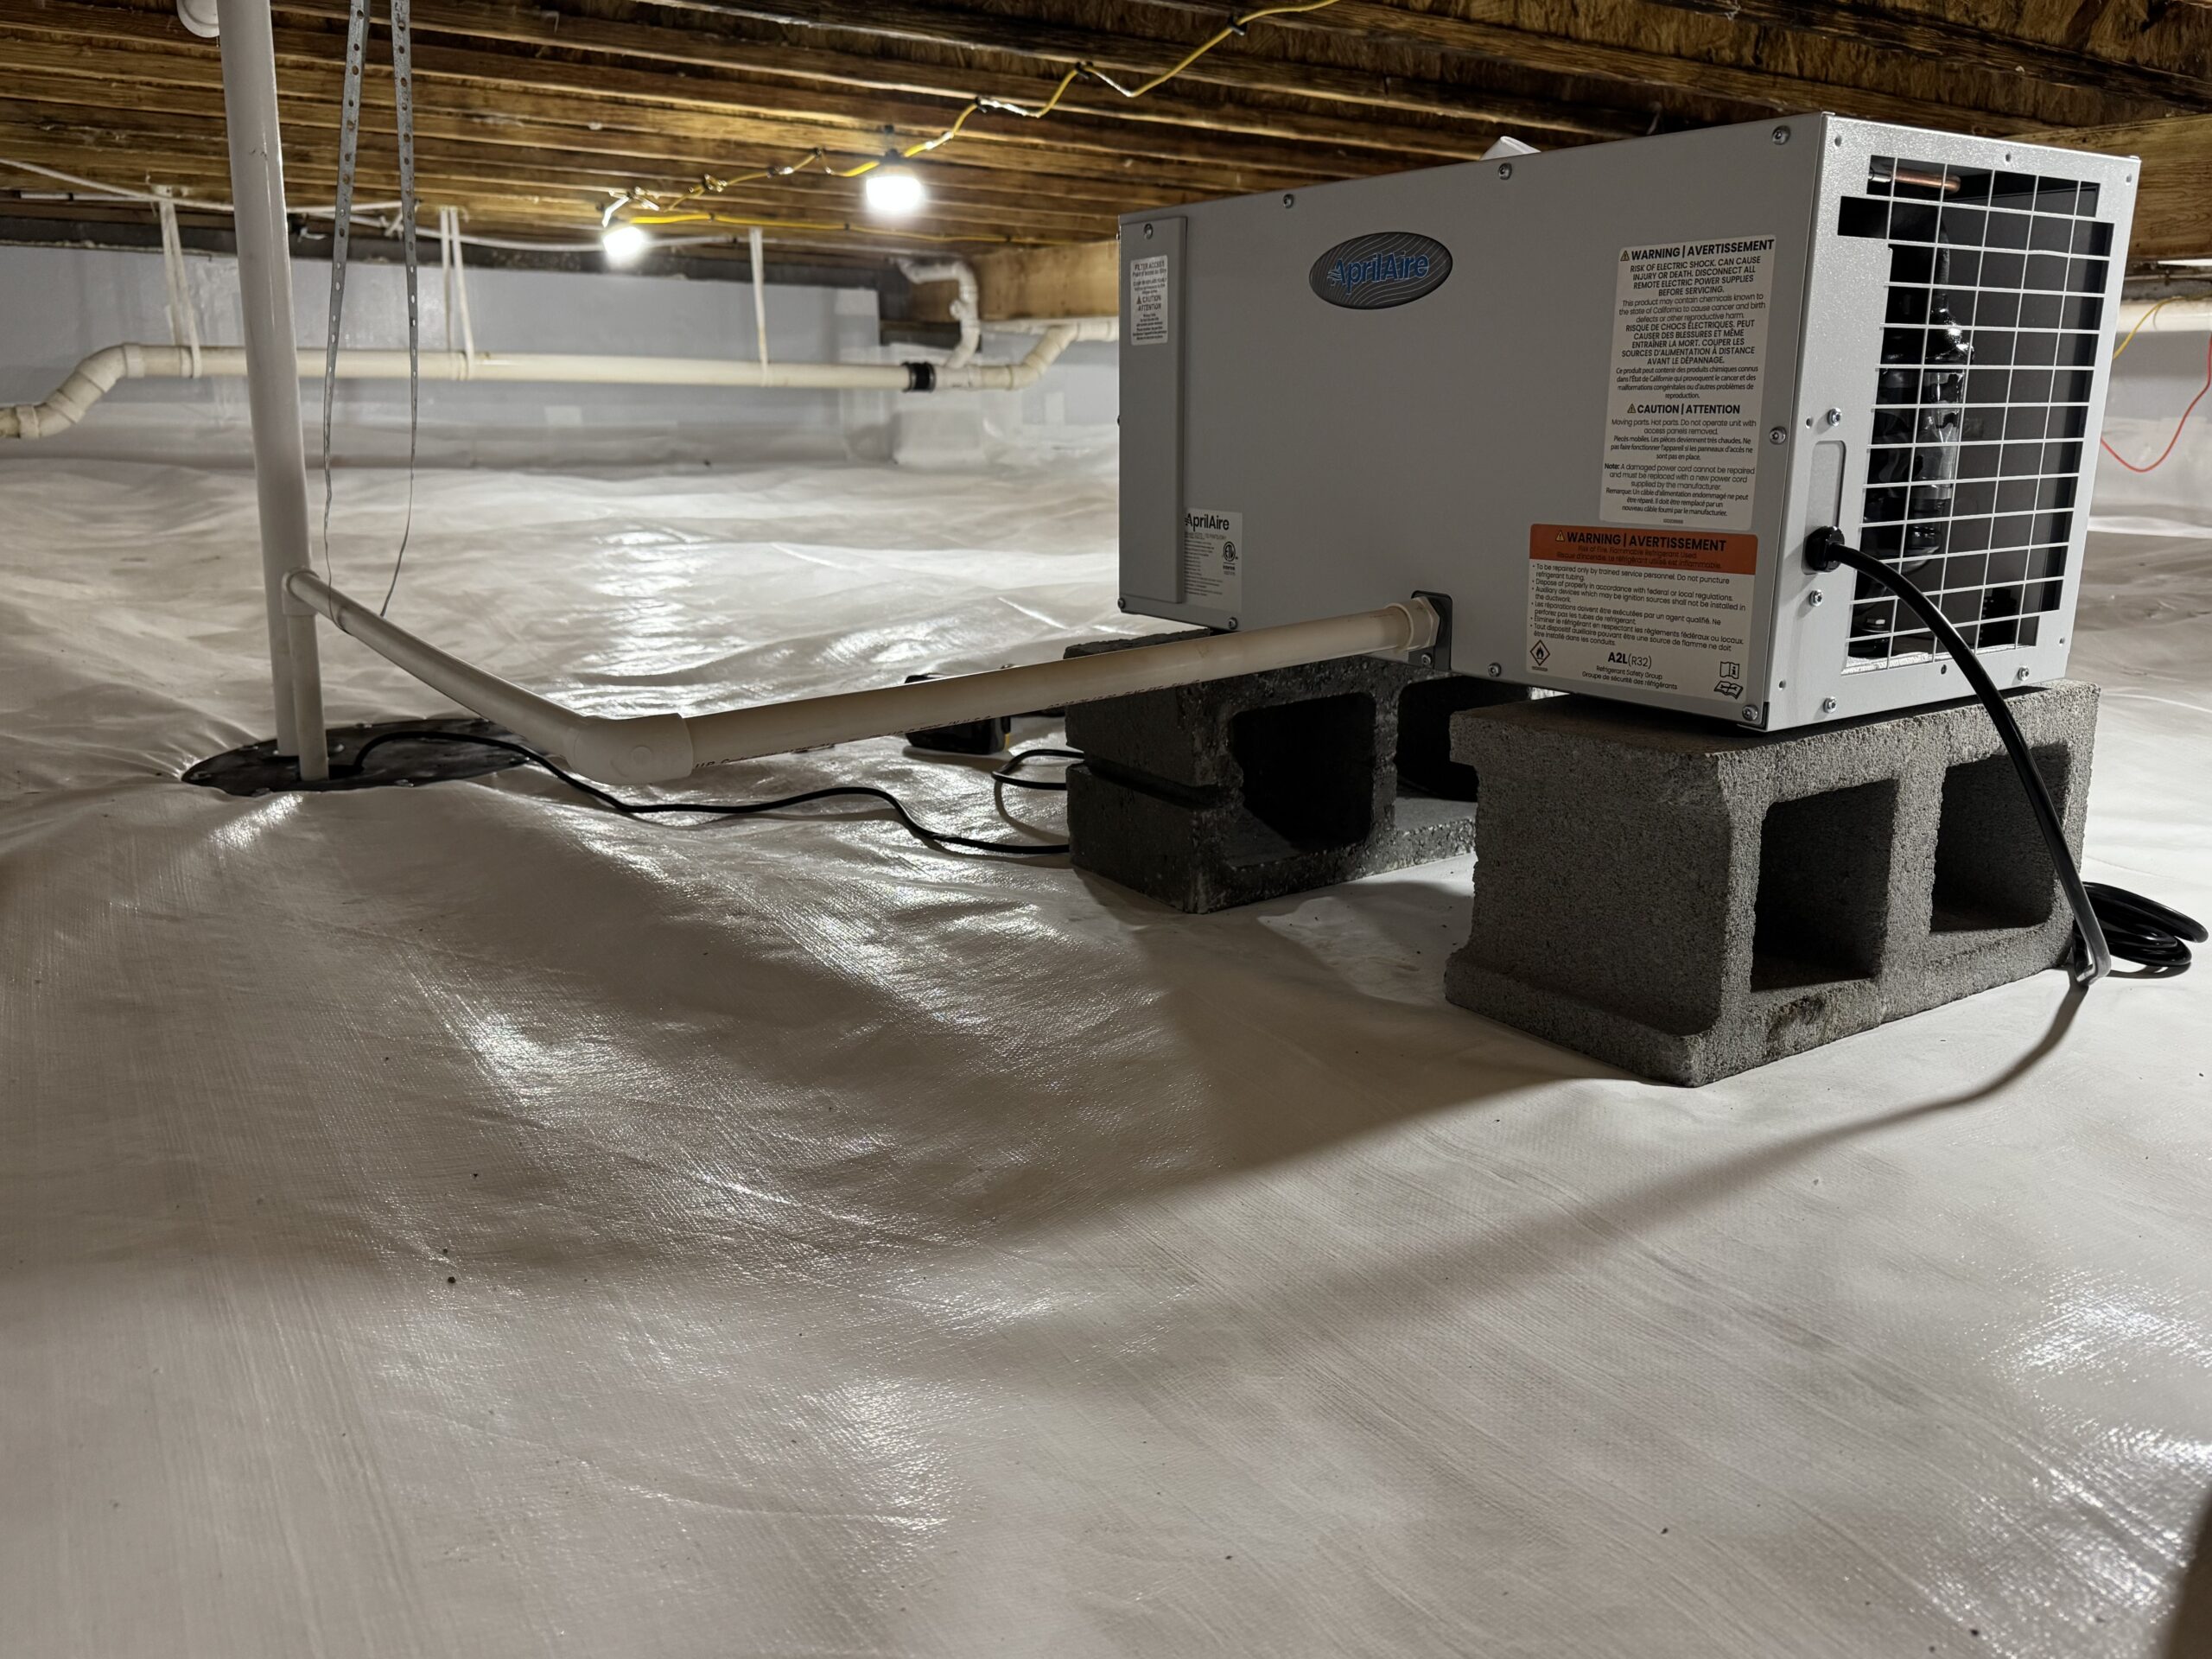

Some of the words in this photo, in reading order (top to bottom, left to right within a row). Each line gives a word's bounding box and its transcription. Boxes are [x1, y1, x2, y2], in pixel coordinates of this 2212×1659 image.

[1631, 247, 1680, 260] WARNING
[1687, 238, 1775, 256] AVERTISSEMENT
[1656, 261, 1688, 270] ELECTRIC
[1689, 259, 1716, 268] SHOCK.
[1718, 257, 1734, 266] CAN
[1735, 256, 1761, 264] CAUSE
[1327, 251, 1430, 295] AprilAire
[1632, 272, 1656, 281] INJURY
[1669, 270, 1694, 278] DEATH.
[1694, 266, 1743, 276] DISCONNECT
[1633, 280, 1660, 289] REMOTE
[1661, 278, 1693, 288] ELECTRIC
[1694, 276, 1719, 285] POWER
[1721, 274, 1753, 283] SUPPLIES
[1658, 288, 1683, 296] BEFORE
[1685, 285, 1724, 295] SERVICING.
[1142, 295, 1161, 303] CAUTION
[1138, 303, 1161, 312] ATTENTION
[1684, 313, 1725, 321] reproductive
[1625, 323, 1649, 332] RISQUE
[1736, 319, 1755, 327] PEUT
[1675, 330, 1713, 339] BLESSURES
[1723, 328, 1745, 337] MÊME
[1631, 340, 1667, 348] ENTRAÎNER
[1701, 338, 1731, 346] COUPER
[1719, 346, 1755, 354] DISTANCE
[1637, 404, 1679, 414] CAUTION
[1685, 404, 1740, 414] ATTENTION
[1611, 418, 1632, 427] Moving
[1625, 463, 1656, 472] damaged
[1185, 512, 1230, 531] AprilAire
[1567, 531, 1621, 545] WARNING
[1629, 535, 1726, 551] AVERTISSEMENT
[1590, 567, 1598, 575] by
[1535, 578, 1557, 587] Dispose
[1564, 582, 1588, 590] properly
[1595, 584, 1631, 593] accordance
[1647, 587, 1669, 595] federal
[1535, 586, 1558, 595] Auxiliary
[1558, 588, 1580, 596] devices
[1599, 592, 1612, 601] may
[1623, 594, 1644, 602] ignition
[1710, 601, 1738, 610] installed
[1596, 664, 1625, 675] Refrigerant
[1626, 669, 1644, 679] Safety
[1644, 671, 1662, 681] Group
[1582, 671, 1601, 679] Groupe
[1644, 680, 1678, 690] réfrigérants
